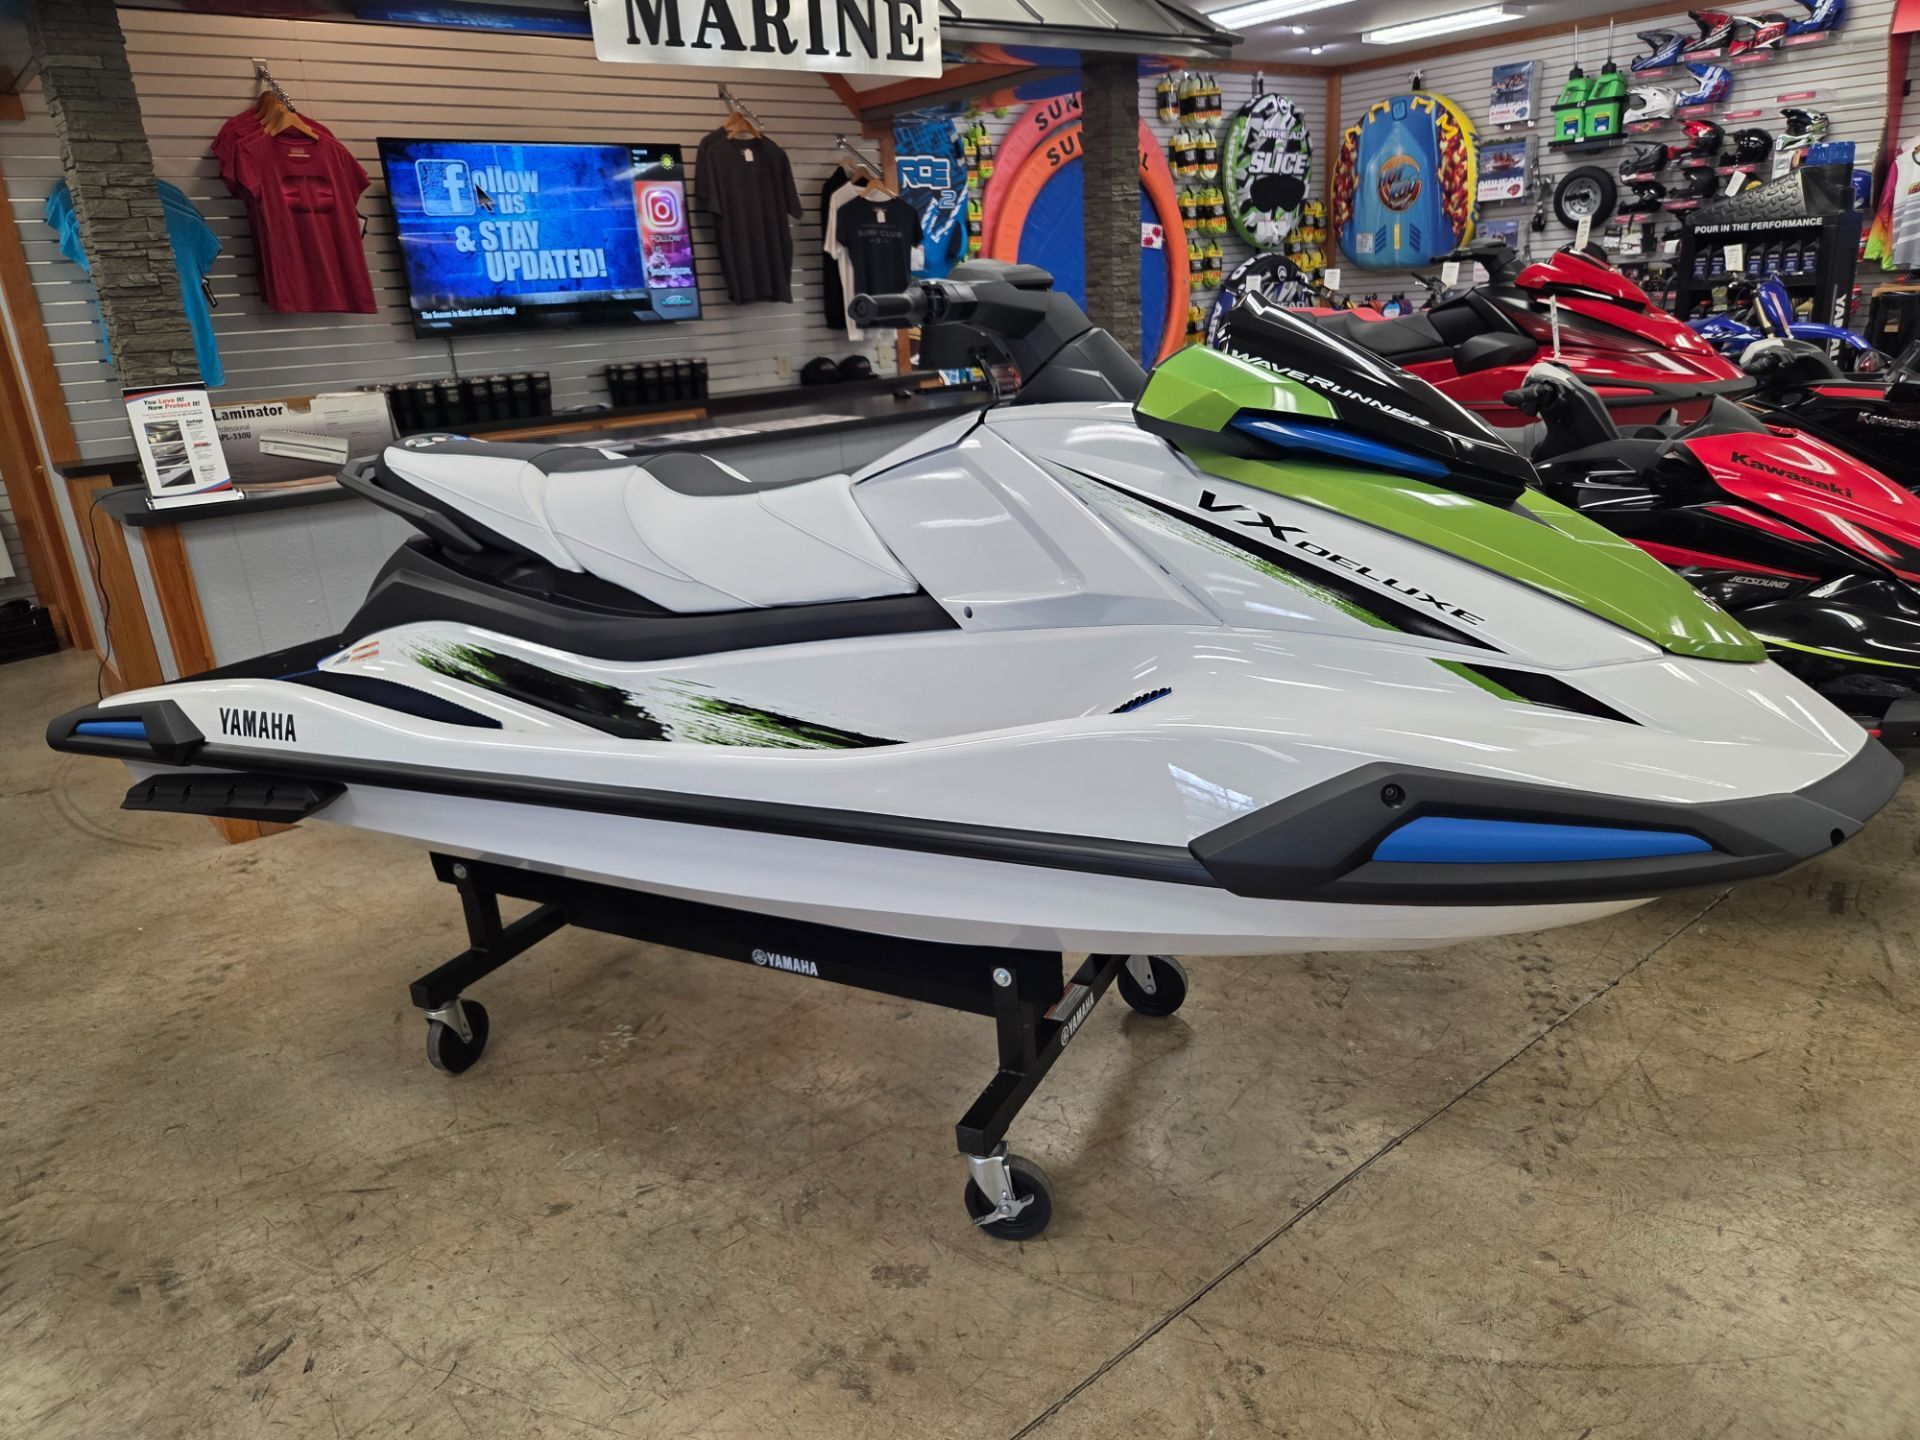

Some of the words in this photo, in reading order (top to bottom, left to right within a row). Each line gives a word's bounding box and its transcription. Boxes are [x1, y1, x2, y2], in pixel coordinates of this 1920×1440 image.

[626, 0, 925, 62] MARINE
[1258, 128, 1304, 140] AIRHEAD
[1248, 147, 1309, 175] SLICE
[499, 193, 526, 215] us
[454, 225, 478, 253] &
[479, 220, 540, 251] STAY
[1694, 225, 1719, 235] POUR
[1720, 224, 1730, 233] IN
[1732, 222, 1750, 232] THE
[1751, 217, 1824, 231] PERFORMANCE
[485, 248, 608, 283] UPDATED!
[158, 397, 175, 405] Love
[1231, 349, 1430, 426] WAVERUNNER
[164, 402, 192, 410] Protect
[213, 404, 284, 422] Laminator
[1731, 451, 1852, 499] Kawasaki
[1198, 490, 1307, 543] VX
[1295, 540, 1485, 626] DELUXE
[1728, 575, 1790, 590] JETSOUND
[219, 707, 297, 742] YAMAHA
[766, 951, 819, 976] YAMAHA
[1067, 992, 1095, 1036] YAMAHA
